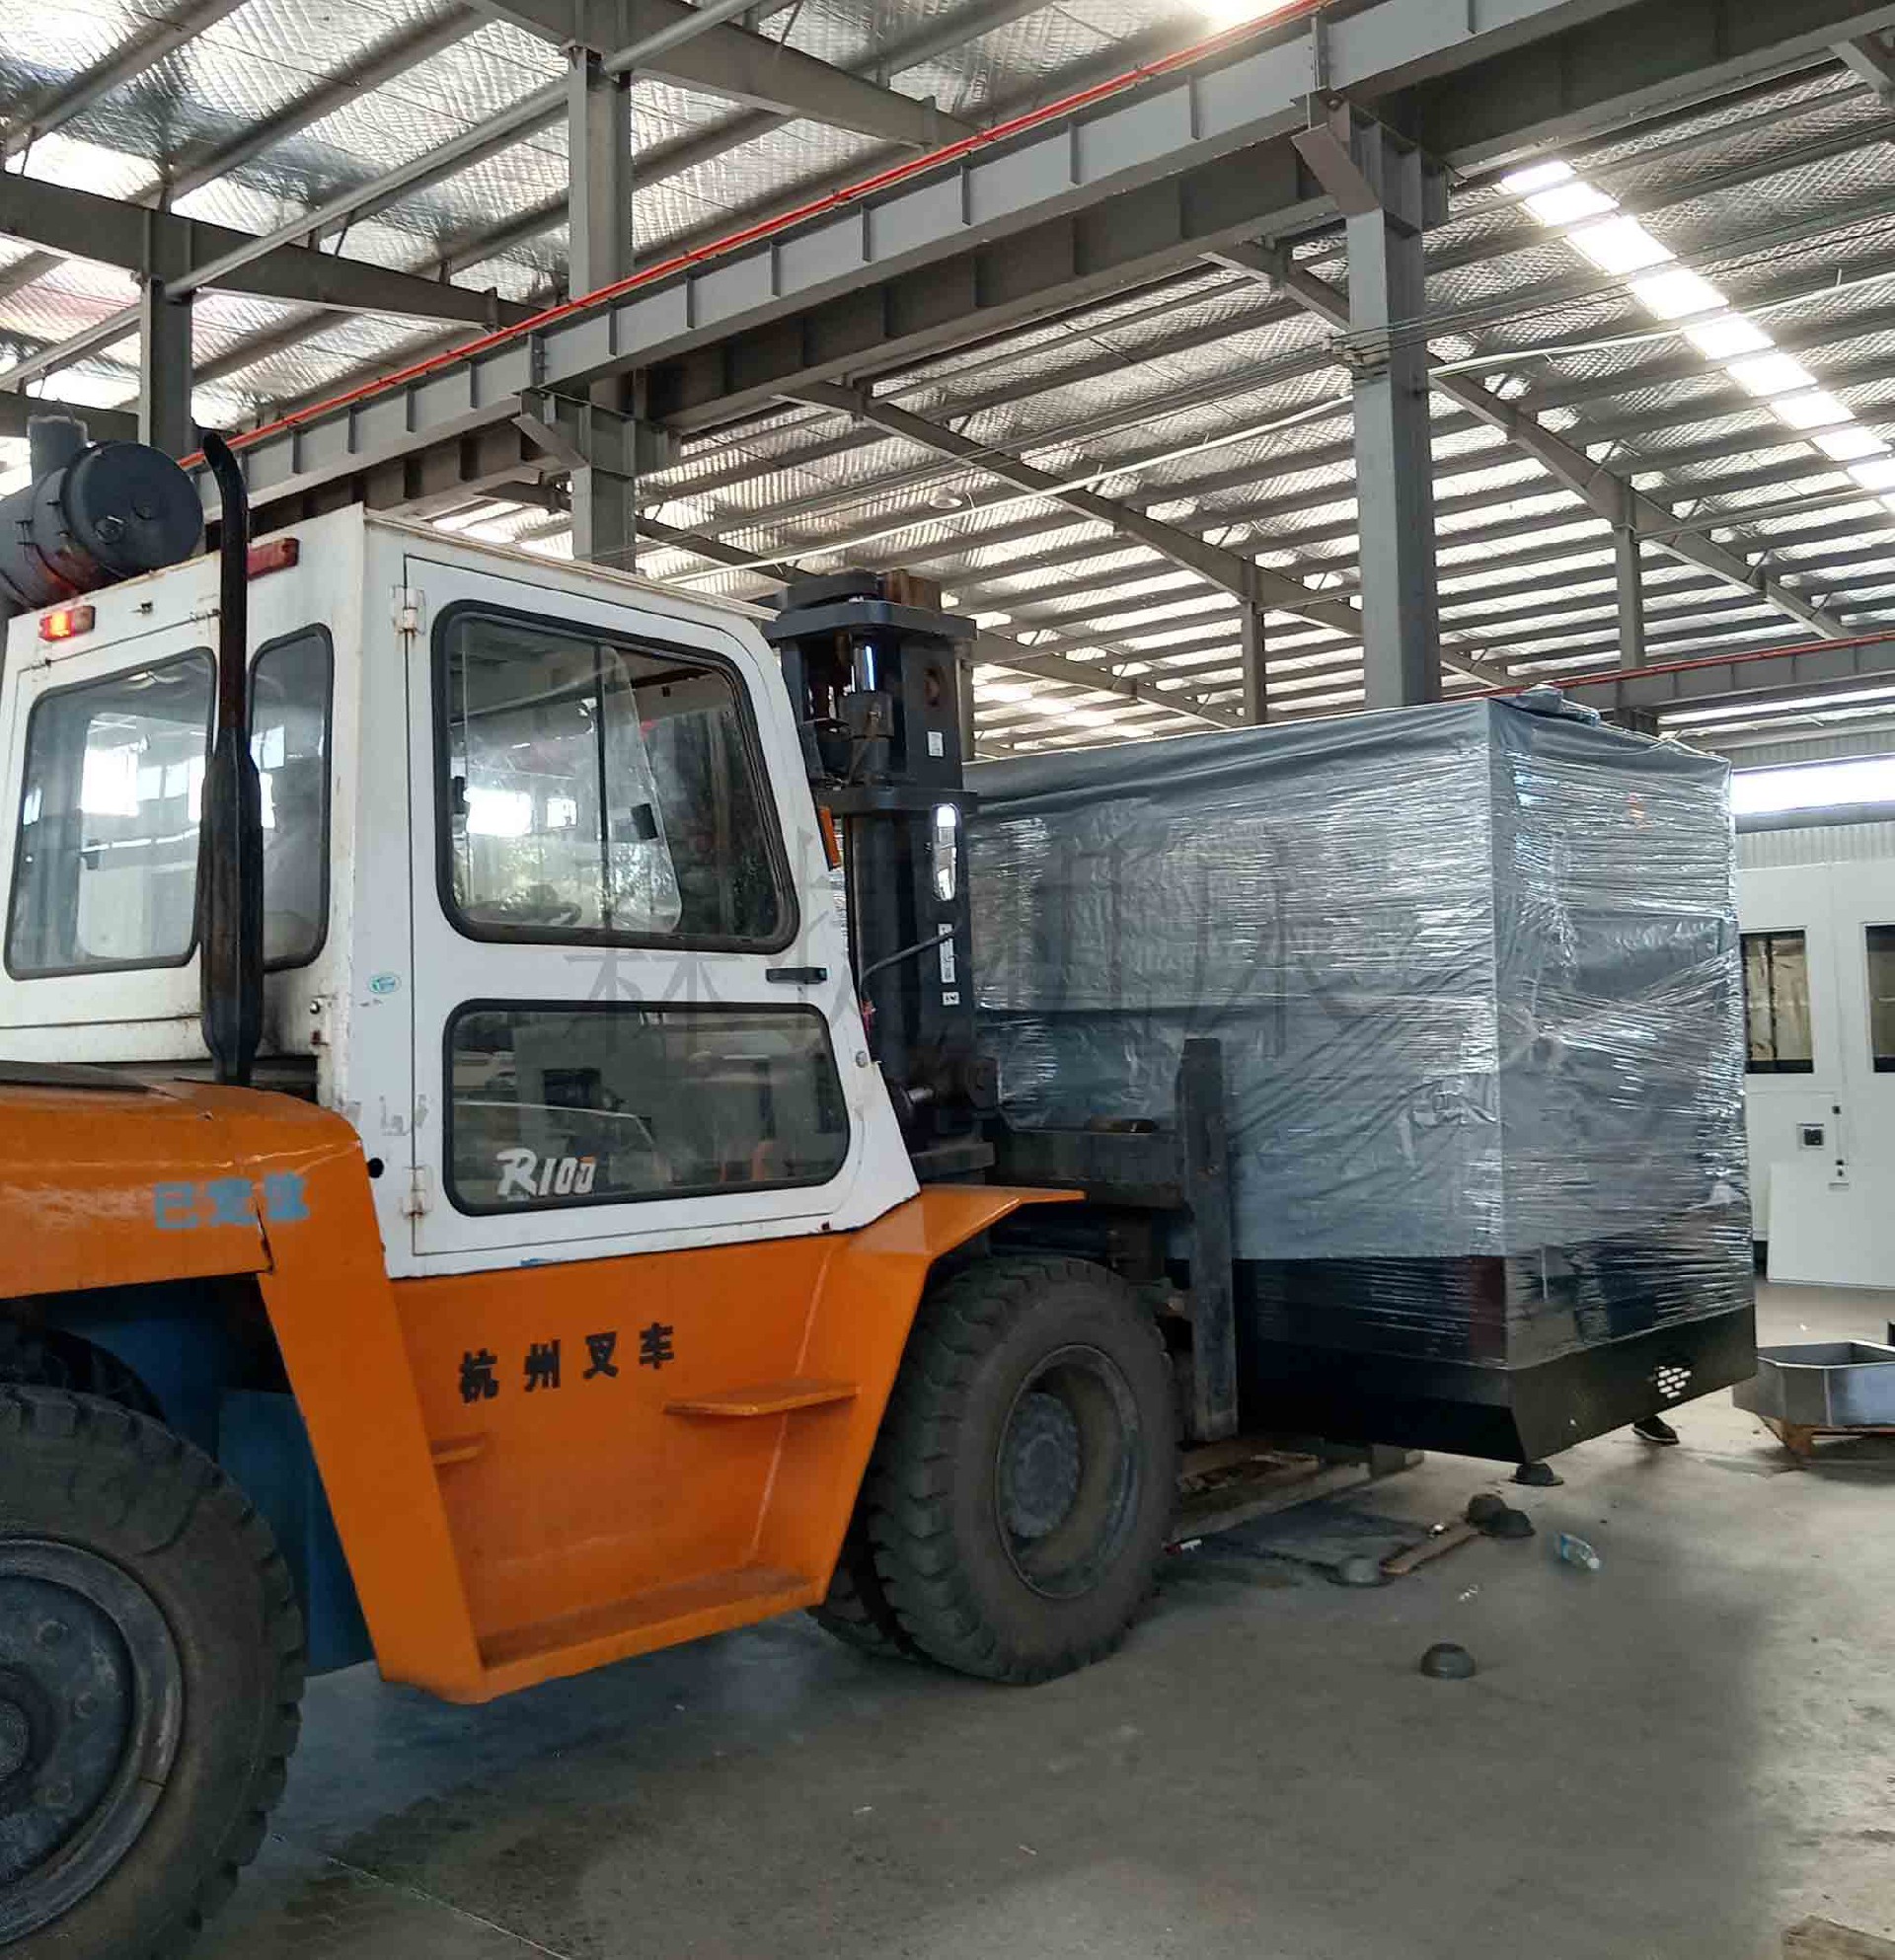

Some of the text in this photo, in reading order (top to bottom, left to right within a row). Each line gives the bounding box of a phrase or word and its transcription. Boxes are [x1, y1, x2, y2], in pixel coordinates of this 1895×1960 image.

[496, 1148, 596, 1197] R100
[459, 1321, 675, 1403] 杭州叉车
